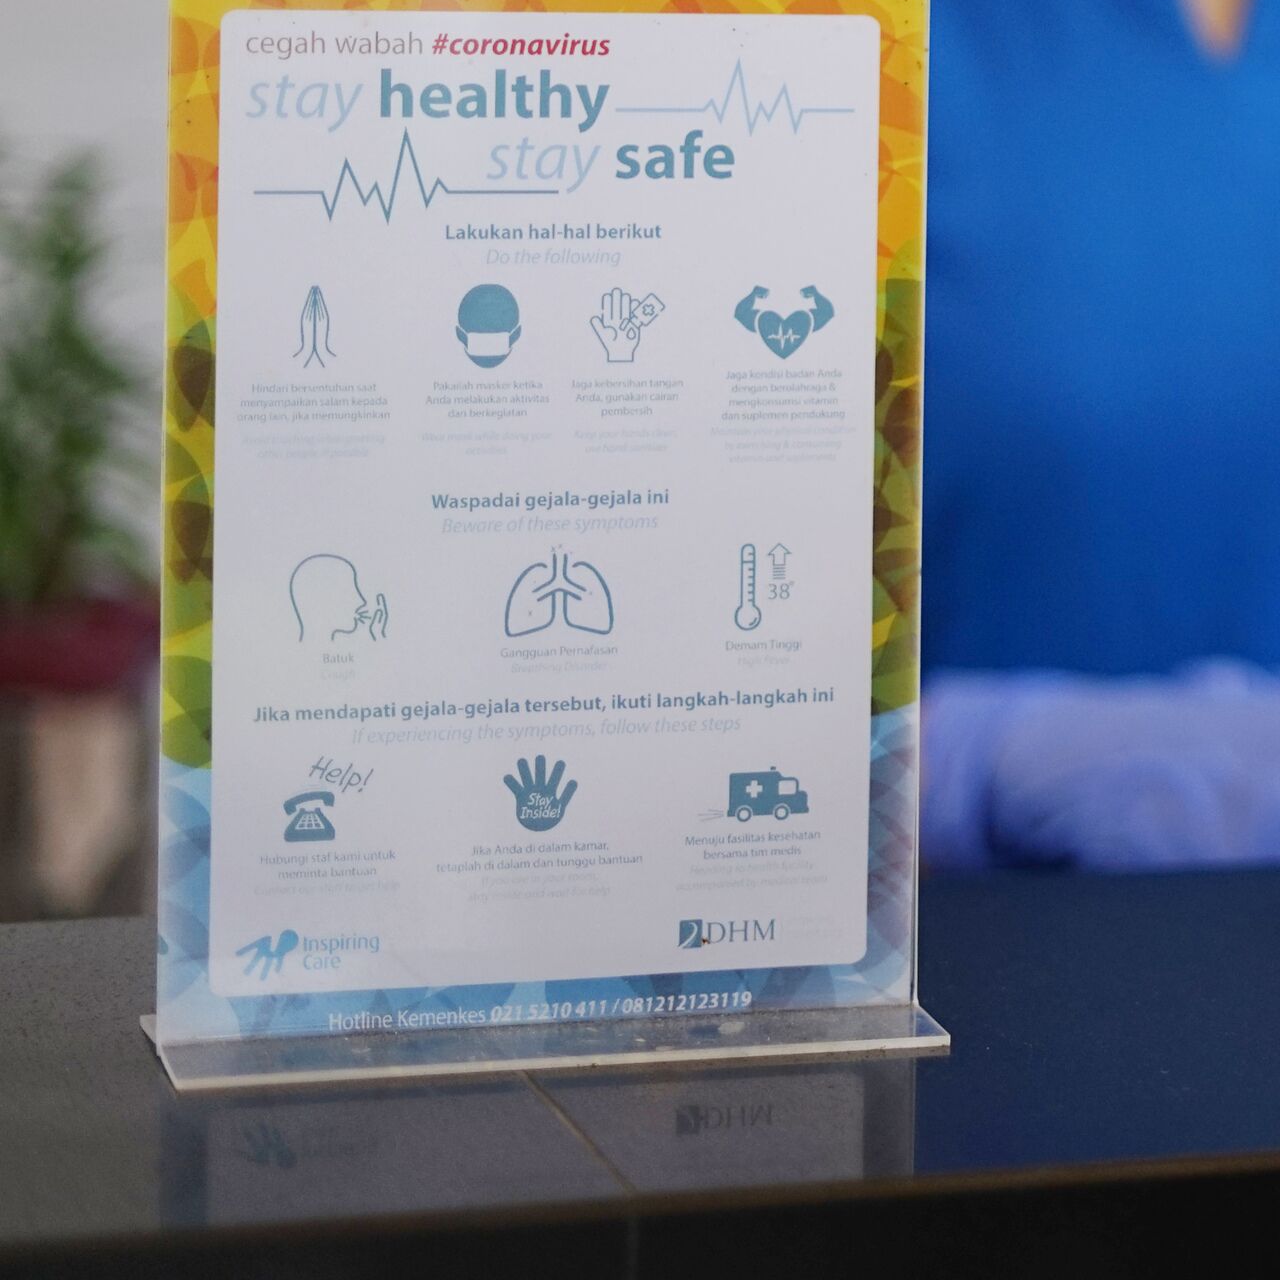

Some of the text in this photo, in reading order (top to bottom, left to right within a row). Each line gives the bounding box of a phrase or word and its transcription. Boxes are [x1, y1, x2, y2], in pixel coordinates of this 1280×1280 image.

[246, 32, 610, 60] cegah wabah #coronavirus
[245, 69, 610, 133] stay healthy
[486, 131, 735, 194] stay safe
[446, 224, 661, 239] Lakukan hal-hal berikut
[486, 246, 623, 269] Do the following
[726, 368, 842, 382] Jaga kondisi badan Anda
[252, 383, 376, 393] Hindari bersentuhan saat
[433, 380, 543, 390] Pakailah masker ketika
[571, 378, 683, 391] Jaga kebersihan tangan
[426, 394, 550, 404] Anda melakukan aktivitas
[601, 405, 653, 418] pembersih
[432, 489, 668, 510] Waspadai gejala-gejala ini
[441, 512, 659, 535] Beware of these symptoms
[501, 646, 618, 661] Gangguan Pernafasan
[725, 640, 801, 653] Demam Tinggi
[322, 654, 354, 664] Batuk
[254, 687, 833, 722] Jika mendapati gejala-gejala tersebut, ikuti langkah-langkah ini
[352, 714, 741, 748] If experiencing the symptoms, follow these steps
[309, 756, 374, 793] Help!
[528, 793, 554, 809] Stay
[520, 804, 561, 819] Inside!
[471, 840, 609, 855] Jika Anda di dalam kamar,
[685, 829, 821, 849] Menuju fasilitas kesehatan
[260, 850, 395, 867] Hubungi staf kami untuk
[703, 846, 802, 860] bersama tim medis
[278, 865, 376, 879] meminta bantuan
[437, 854, 643, 876] tetaplah di dalam dan tunggu bantuan
[706, 919, 776, 944] DHM
[302, 932, 379, 954] Inspiring
[302, 953, 342, 971] Care
[328, 991, 752, 1029] Hotline Kemenkes 021 5210 411 / 081212123119
